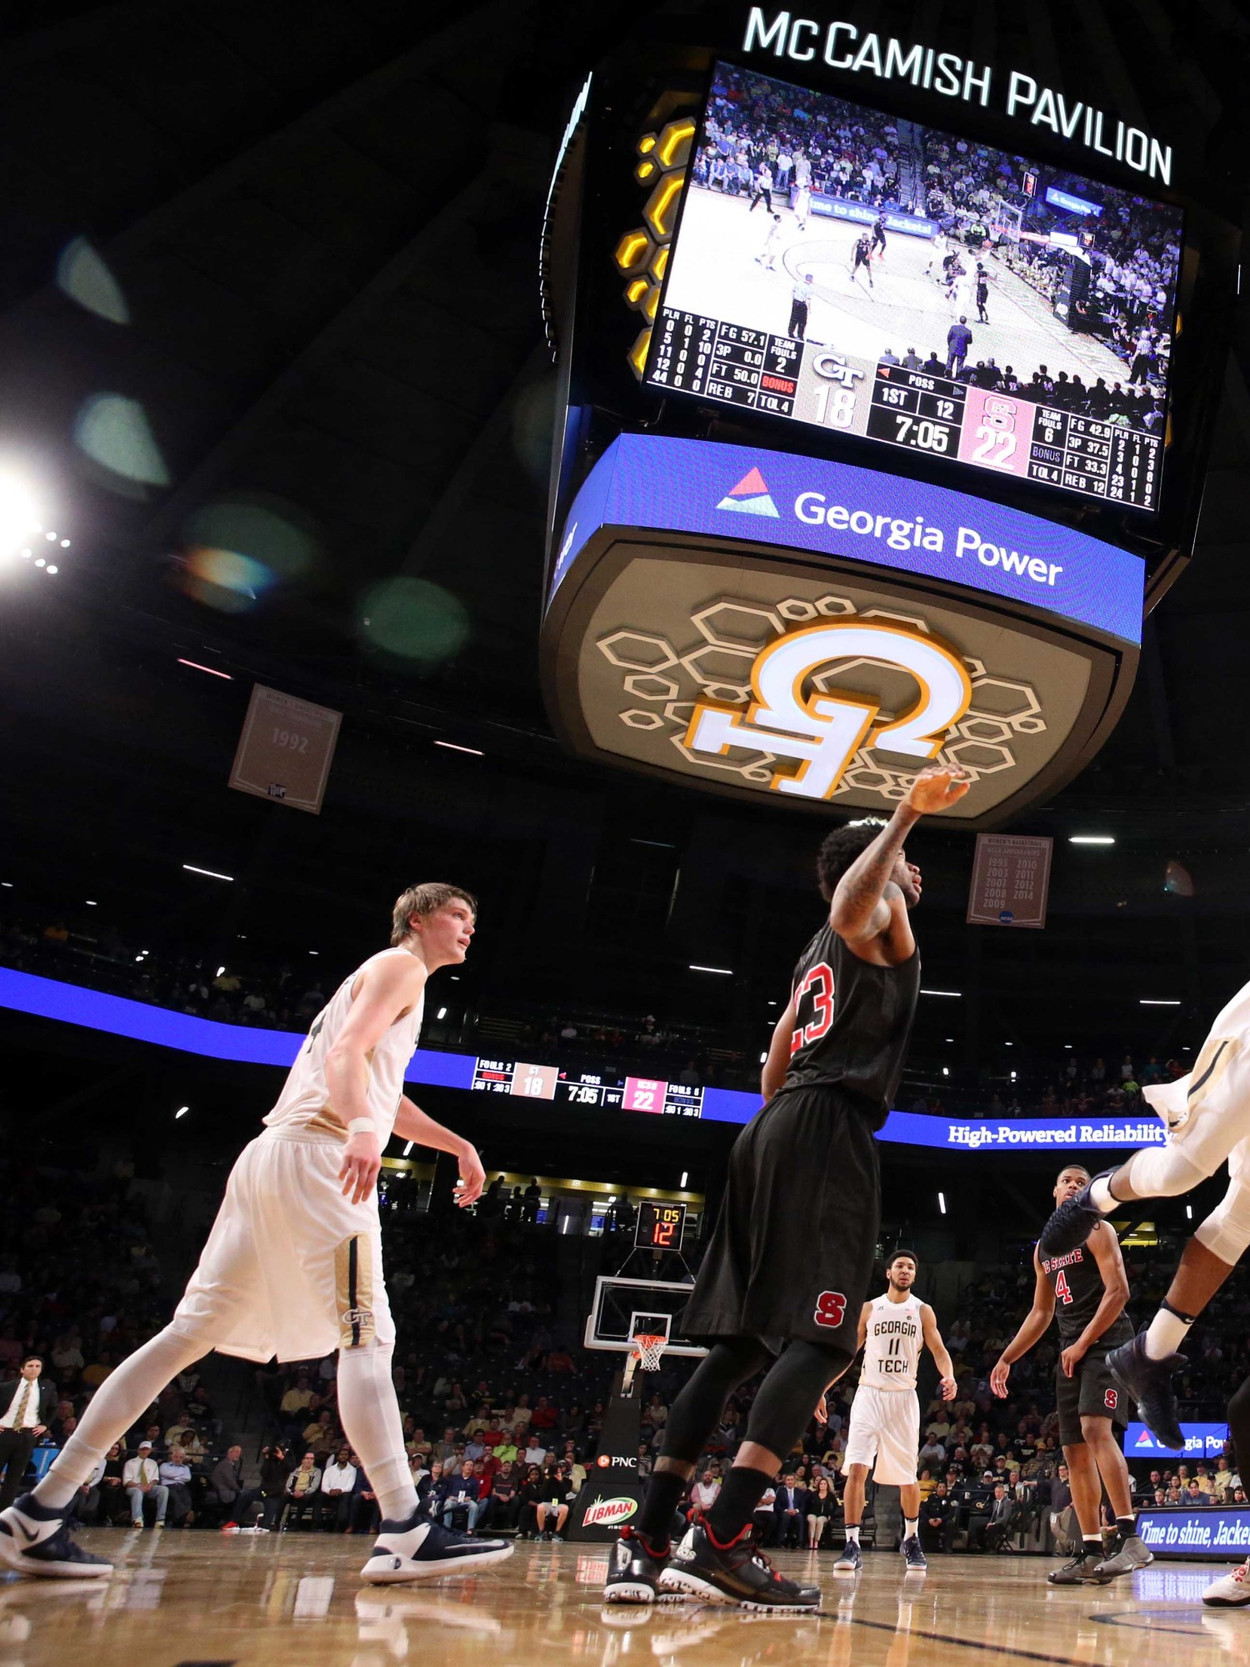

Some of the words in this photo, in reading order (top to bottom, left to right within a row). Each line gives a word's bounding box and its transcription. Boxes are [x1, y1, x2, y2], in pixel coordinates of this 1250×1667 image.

[1007, 69, 1173, 186] PAVILION
[663, 308, 680, 320] PLR
[684, 314, 694, 324] FL
[699, 318, 716, 330] PTS
[721, 325, 737, 339] FG
[741, 330, 765, 346] 57.1
[774, 338, 796, 350] TEAM
[659, 345, 673, 357] 11
[698, 341, 712, 354] 10
[716, 344, 732, 357] 3P
[744, 350, 762, 366] 0.0
[771, 346, 797, 359] FOULS
[656, 357, 670, 370] 12
[775, 357, 787, 373] 2
[652, 370, 668, 383] 44
[712, 363, 728, 376] FT
[733, 369, 759, 385] 50.0
[908, 374, 935, 391] POSS
[708, 382, 733, 399] REB
[747, 392, 755, 404] 7
[761, 376, 794, 393] BONUS
[760, 394, 779, 411] TOL
[780, 401, 790, 412] 4
[814, 385, 856, 429] 18
[882, 387, 908, 406] 1ST
[936, 400, 955, 419] 12
[1038, 417, 1062, 430] FOULS
[1042, 409, 1061, 421] TEAM
[895, 415, 949, 452] 7:05
[1044, 428, 1054, 442] 6
[1070, 419, 1085, 432] FG
[1089, 423, 1111, 439] 42.9
[1068, 436, 1082, 449] 3P
[1087, 441, 1109, 457] 37.5
[1114, 430, 1129, 440] PLR
[1132, 435, 1142, 444] FL
[1144, 438, 1159, 448] PTS
[971, 426, 1018, 471] 22
[1032, 446, 1061, 463] BONUS
[1032, 464, 1050, 480] TOL
[1051, 470, 1058, 482] 4
[1066, 455, 1080, 468] FT
[1085, 459, 1107, 475] 33.3
[1065, 474, 1087, 489] REB
[1093, 481, 1105, 494] 12
[1111, 474, 1125, 487] 23
[1110, 486, 1123, 499] 24
[793, 490, 945, 552] Georgia
[954, 524, 1064, 586] Power
[272, 728, 308, 754] 1992
[1016, 859, 1037, 869] 2010
[986, 878, 1007, 888] 2007
[1014, 880, 1034, 890] 2012
[1016, 870, 1034, 880] 2011
[984, 888, 1007, 899] 2008
[983, 898, 1005, 909] 2009
[479, 1059, 504, 1071] FOULS
[524, 1077, 544, 1096] 18
[580, 1073, 601, 1085] POSS
[568, 1085, 599, 1105] 7:05
[668, 1084, 692, 1095] FOULS
[632, 1091, 654, 1110] 22
[948, 1125, 1077, 1148] High-Powered
[1079, 1124, 1174, 1146] Reliability
[653, 1222, 676, 1245] 12
[1055, 1269, 1074, 1305] 4
[342, 1308, 373, 1326] GT
[874, 1320, 917, 1339] GEORGIA
[889, 1339, 901, 1355] 11
[878, 1359, 909, 1373] TECH
[611, 1456, 637, 1468] PNC
[582, 1501, 634, 1527] LIBMAN
[1141, 1520, 1165, 1544] Time
[1166, 1522, 1178, 1544] to
[1180, 1520, 1211, 1548] shine,
